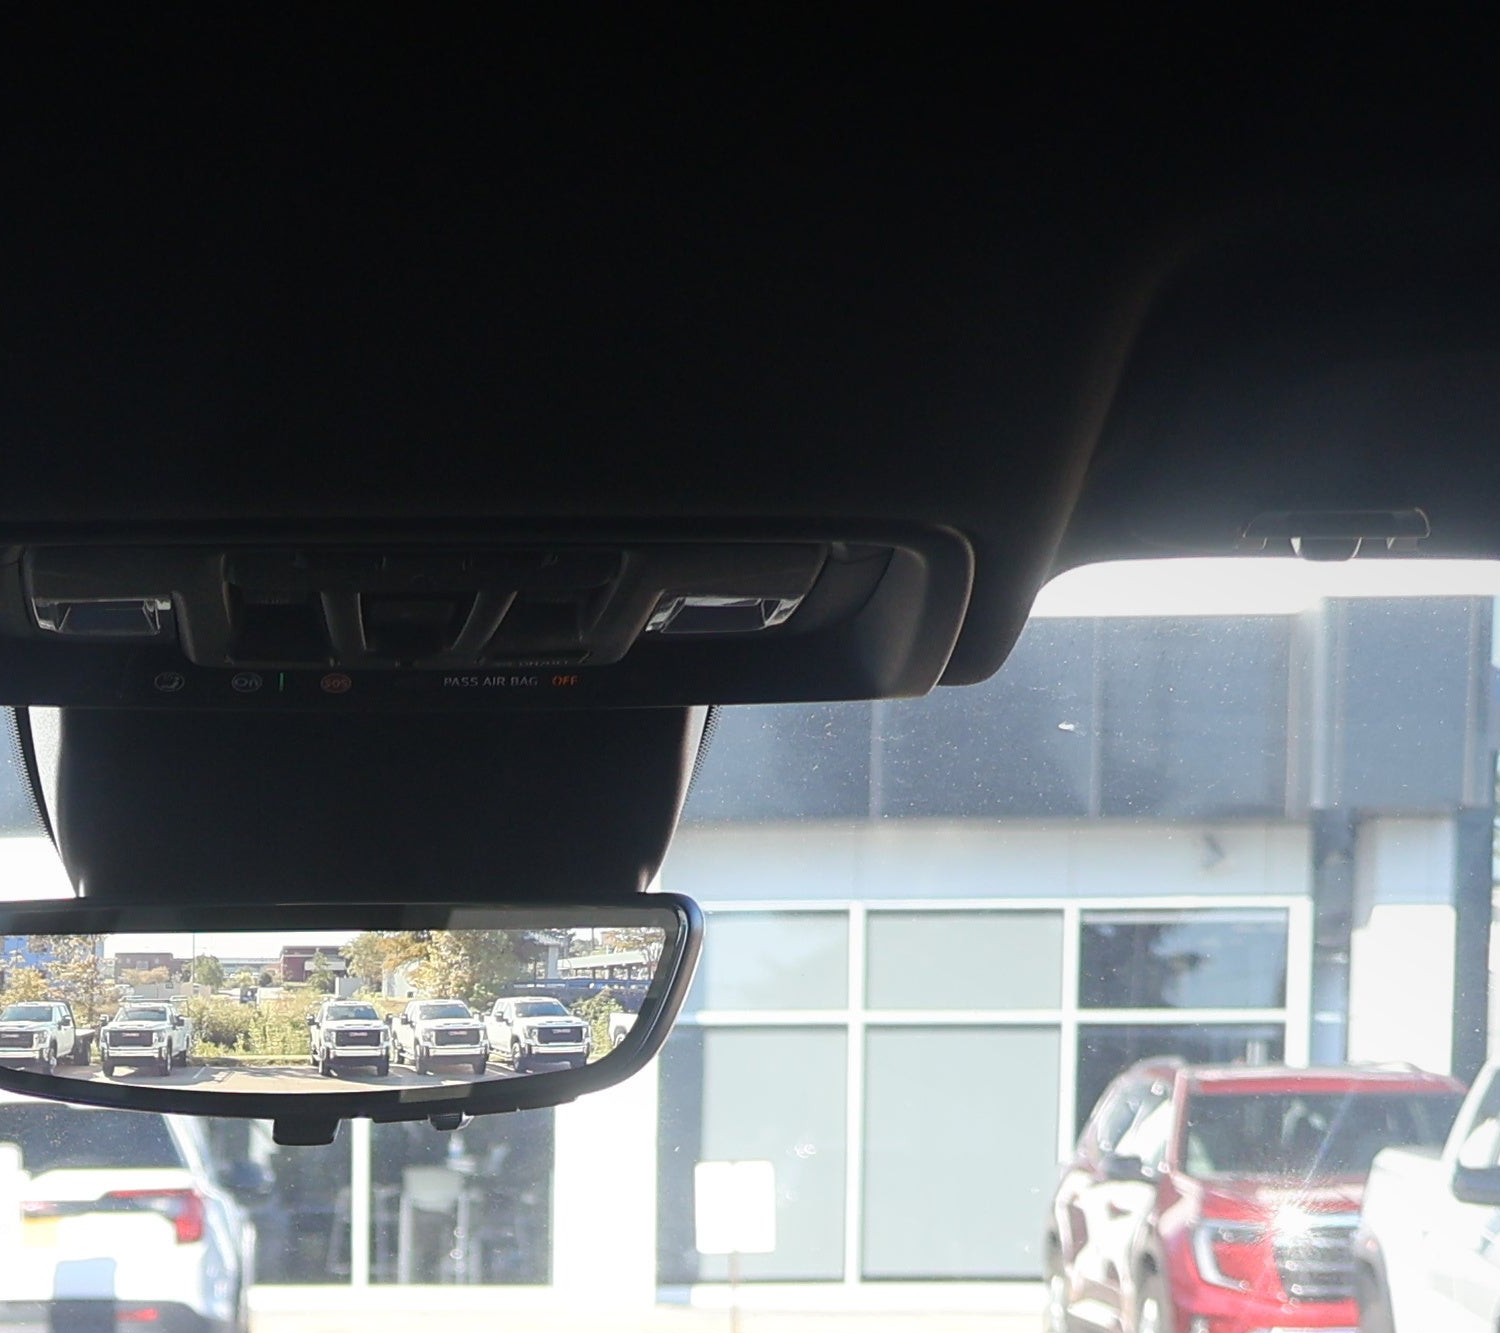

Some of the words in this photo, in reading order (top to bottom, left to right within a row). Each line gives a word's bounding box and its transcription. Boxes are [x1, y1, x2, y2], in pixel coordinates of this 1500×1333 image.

[443, 676, 479, 688] PASS
[482, 676, 506, 687] AIR
[509, 676, 538, 687] BAG
[551, 674, 578, 687] OFF
